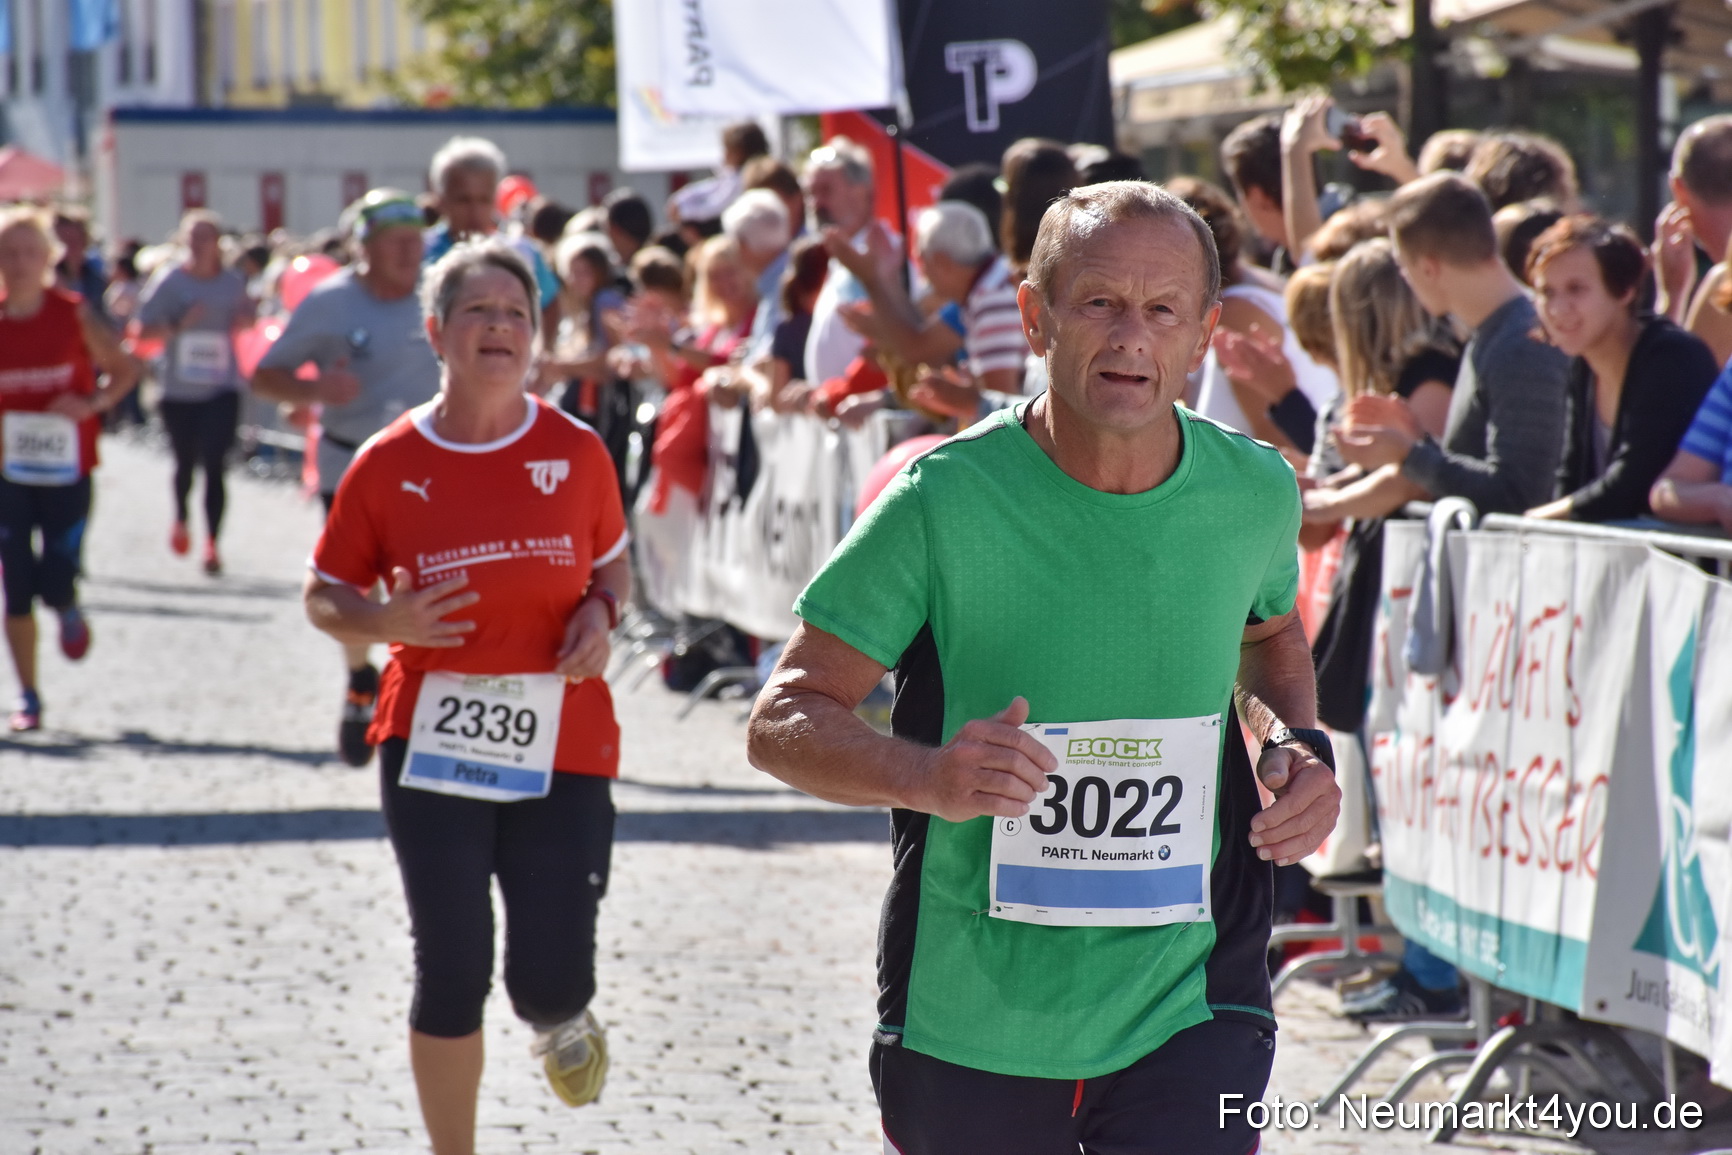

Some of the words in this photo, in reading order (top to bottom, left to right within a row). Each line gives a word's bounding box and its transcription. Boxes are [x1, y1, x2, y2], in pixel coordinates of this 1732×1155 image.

[434, 696, 537, 747] 2339
[1067, 738, 1163, 759] BOCK
[454, 761, 498, 785] Petra
[1066, 758, 1095, 766] inspired
[1097, 758, 1106, 767] by
[1132, 760, 1162, 768] concepts
[1029, 774, 1183, 838] 3022
[1006, 820, 1014, 832] C
[1041, 846, 1088, 860] PARTL
[1092, 848, 1154, 861] Neumarkt
